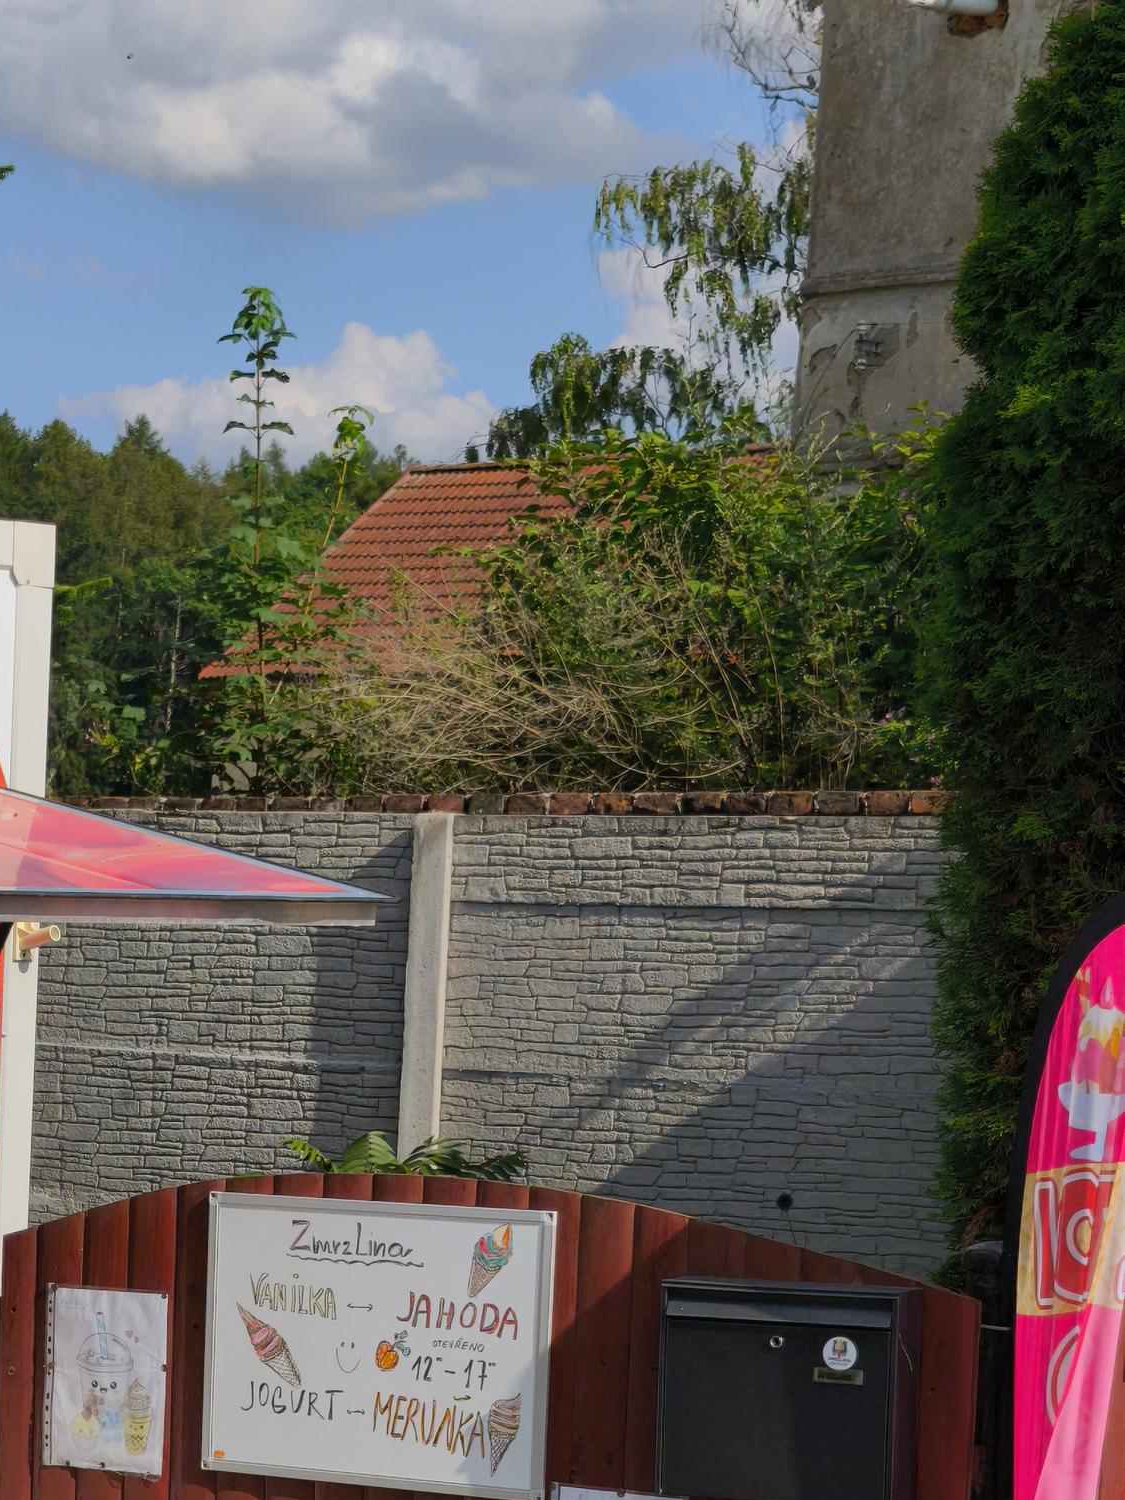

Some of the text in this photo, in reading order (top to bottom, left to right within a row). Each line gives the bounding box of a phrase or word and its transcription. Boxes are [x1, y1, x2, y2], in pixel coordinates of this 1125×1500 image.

[396, 1292, 518, 1340] JAHODA
[432, 1337, 485, 1353] OTEVŘENO
[240, 1381, 344, 1420] JOGURT
[373, 1391, 485, 1458] MERUŇKA
